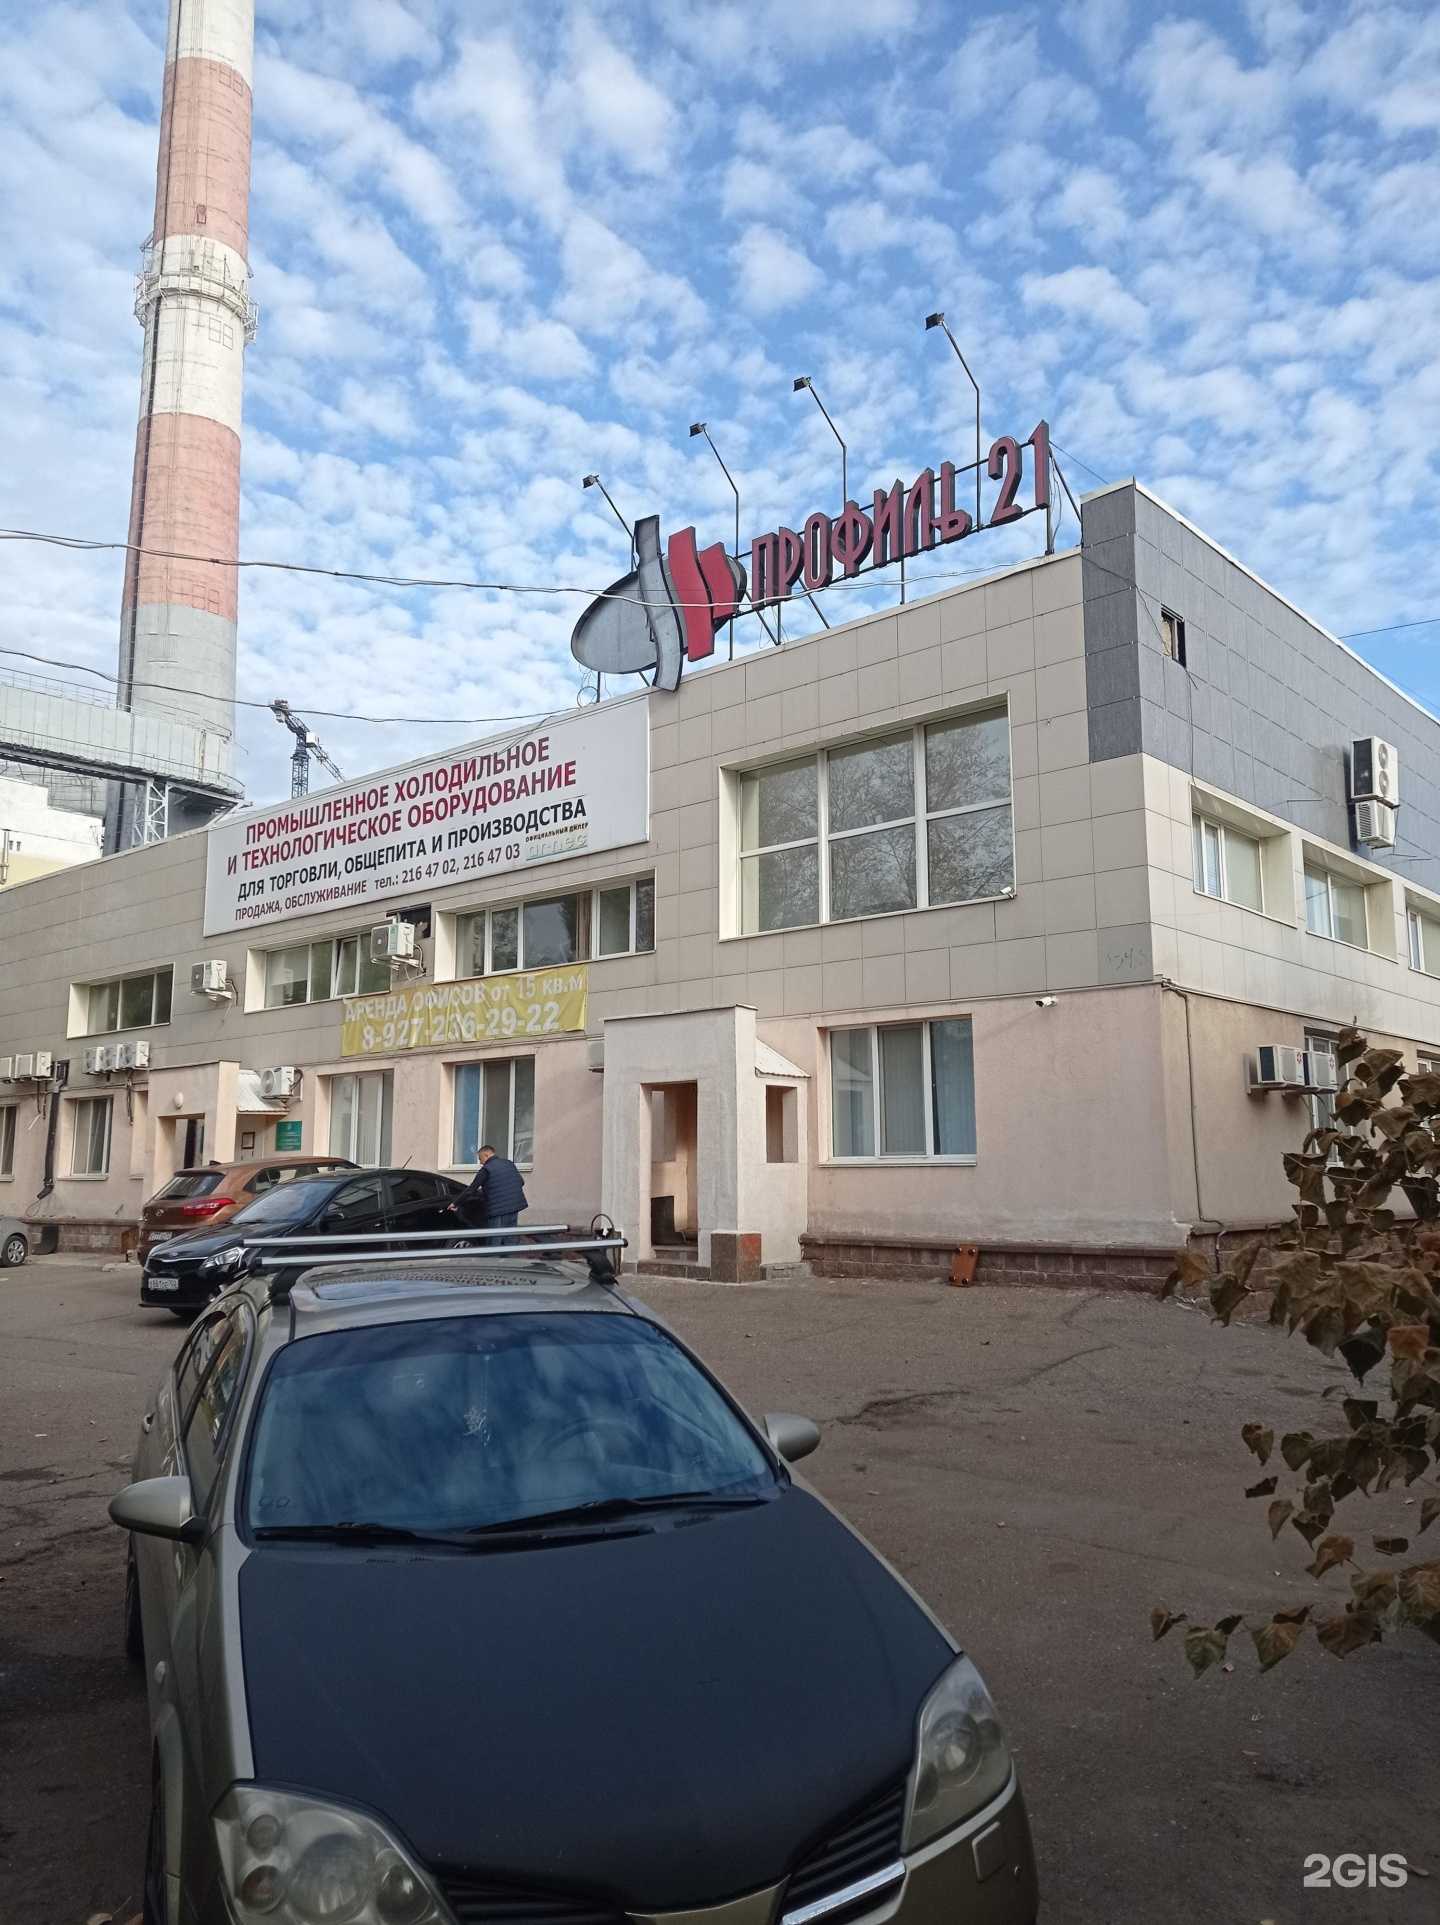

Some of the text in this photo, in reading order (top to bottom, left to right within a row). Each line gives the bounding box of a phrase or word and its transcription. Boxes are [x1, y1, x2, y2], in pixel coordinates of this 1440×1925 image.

[752, 419, 1049, 609] ПРОФИЛЬ 21
[227, 760, 576, 875] И ТЕХНОЛОГИЧЕСКОЕ ОБОРУДОВАНИЕ
[246, 737, 549, 845] ПРОМЫШЛЕННОЕ ХОЛОДИЛЬНОЕ
[525, 822, 588, 842] ОФИЦИАЛЬНЫЙ ДИЛЕР
[235, 843, 520, 921] ПРОДАЖА, ОБСЛУЖИВАНИЕ тел.: 216 47 02, 216 47 03
[238, 799, 586, 902] ДЛЯ ТОРГОВЛИ, ОБЩЕПИТА И ПРОИЗВОДСТВА
[345, 997, 407, 1022] АРЕНДА
[414, 984, 485, 1011] ОФИСОВ
[518, 974, 536, 999] 15
